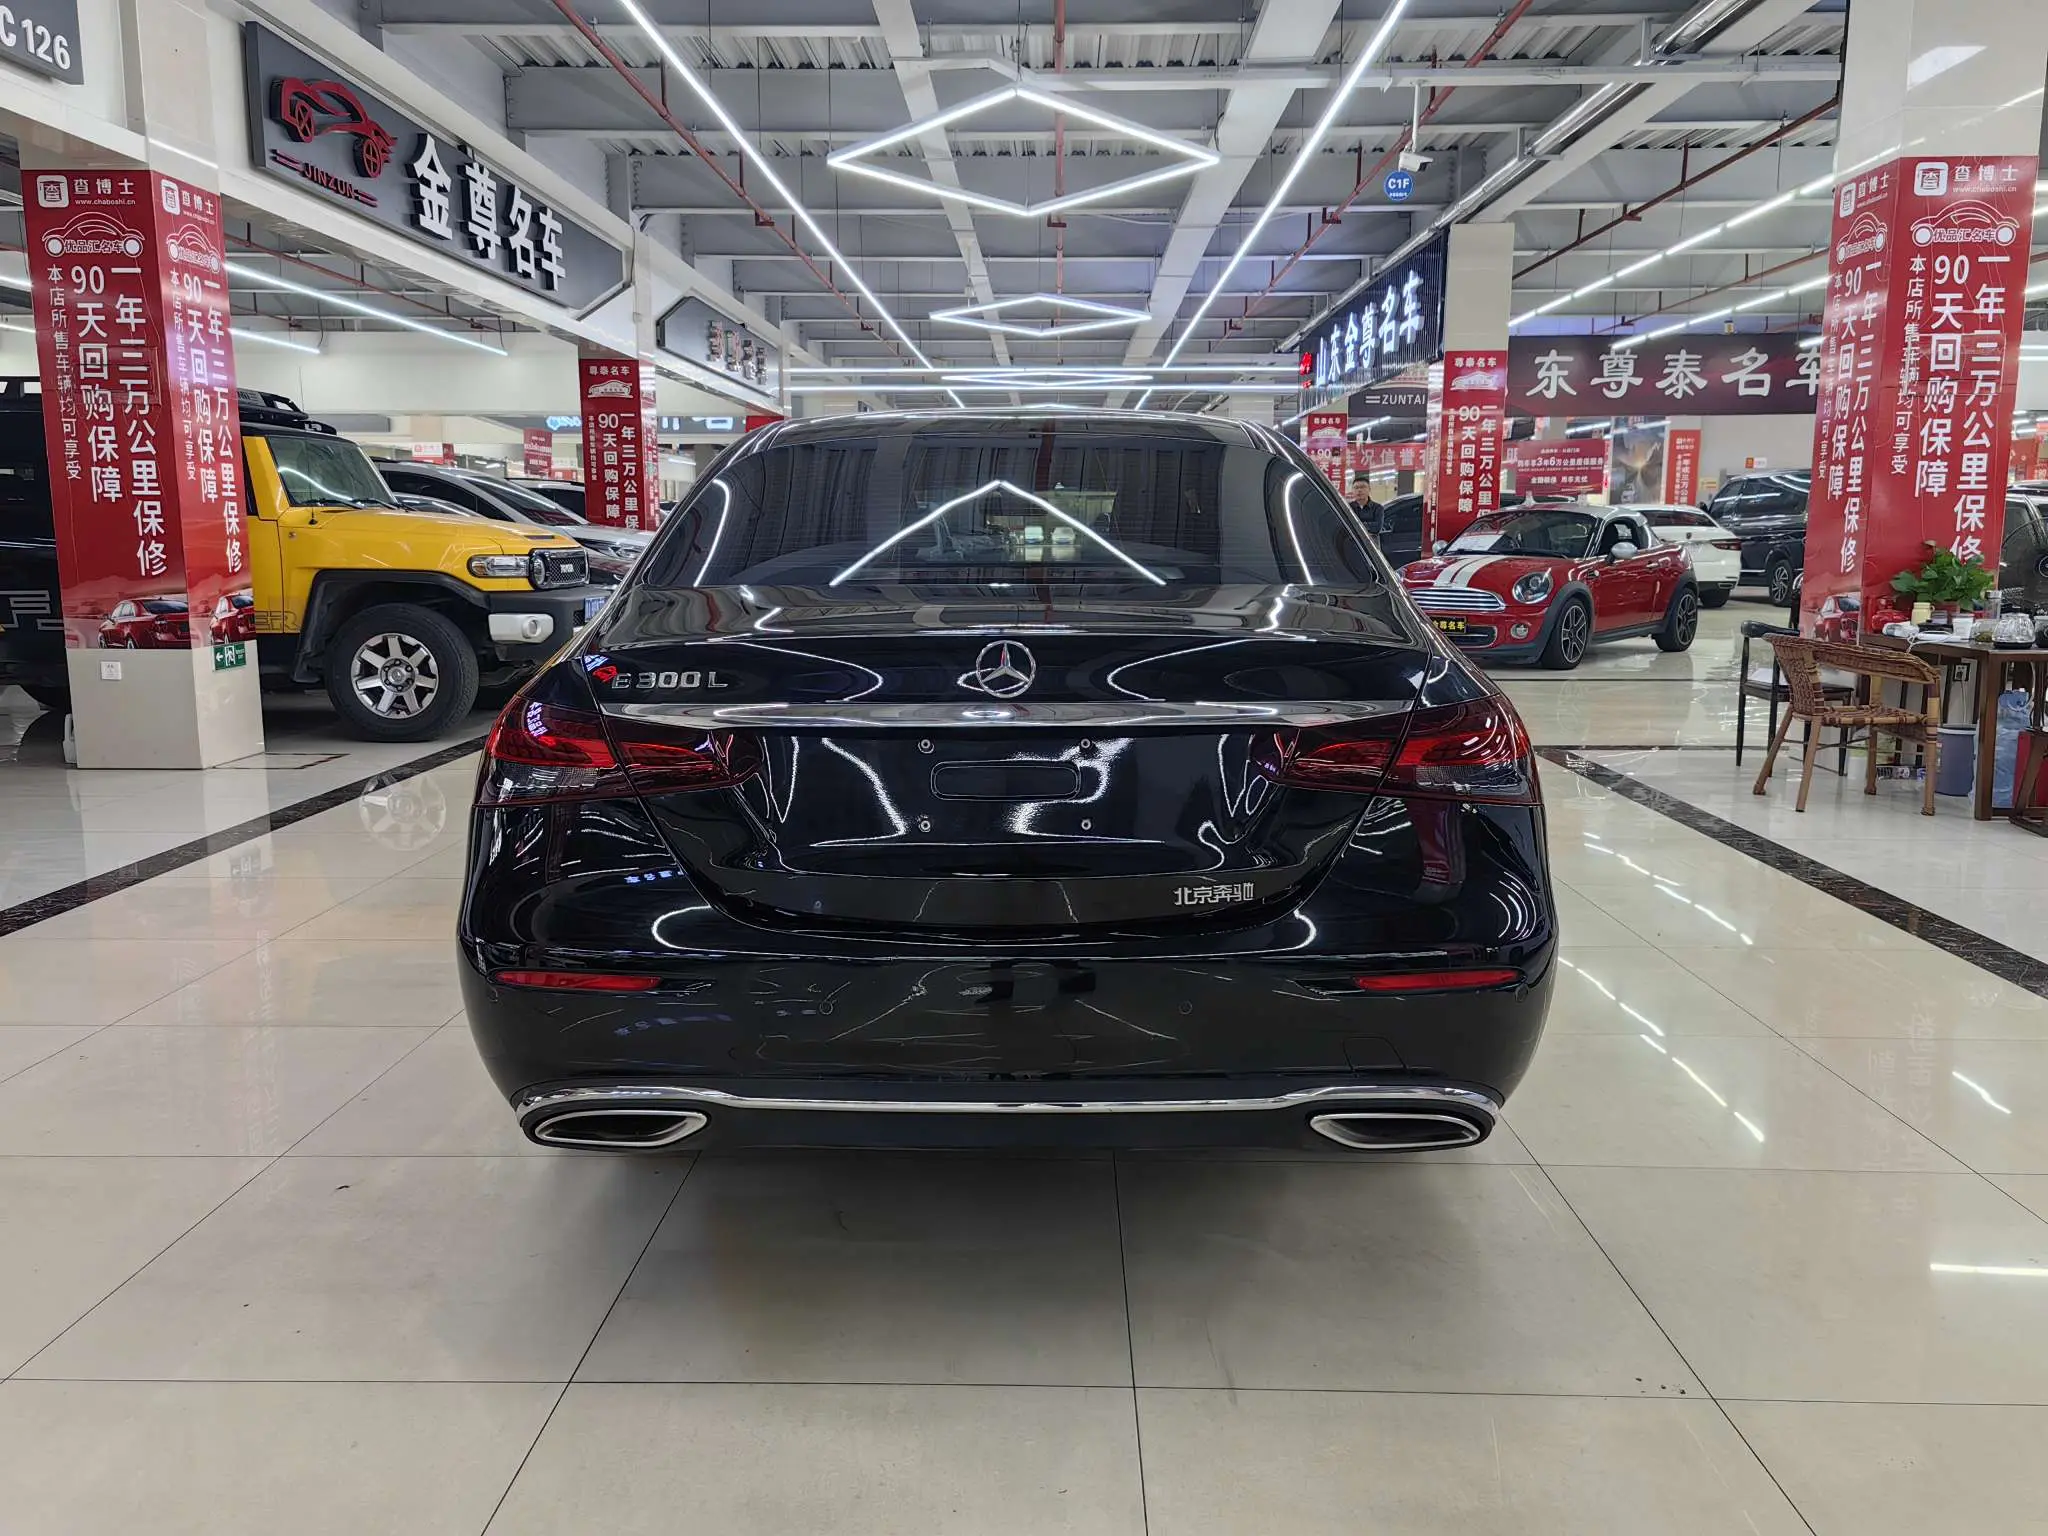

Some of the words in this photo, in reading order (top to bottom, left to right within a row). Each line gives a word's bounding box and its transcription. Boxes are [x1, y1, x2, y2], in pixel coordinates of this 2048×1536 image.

[21, 18, 71, 70] 126
[304, 164, 356, 199] JINZUN
[412, 133, 566, 292] 金尊名车
[1388, 178, 1410, 189] C1F
[47, 264, 82, 480] 本店所售车辆均可享受
[71, 265, 123, 503] 90天回购保障
[183, 272, 219, 503] 90天回购保障
[1316, 269, 1424, 387] 山东金尊名车
[1526, 346, 1825, 400] 东尊泰名车
[1828, 266, 1862, 501] 90天回购保障
[1914, 255, 1970, 498] 90天回购保障
[111, 267, 168, 577] 一年三万公里保修
[204, 279, 242, 573] 一年三万公里保修
[598, 413, 621, 519] 90天回购保障
[1382, 395, 1426, 405] ZUNTAI
[1458, 405, 1480, 513] 90天回购保障
[1840, 261, 1882, 575] 一年三万公里保修
[1950, 255, 2011, 565] 一年三万公里保修
[612, 673, 631, 689] E
[636, 671, 701, 689] 300
[708, 671, 728, 688] L
[1174, 882, 1255, 906] 北京奔驰
